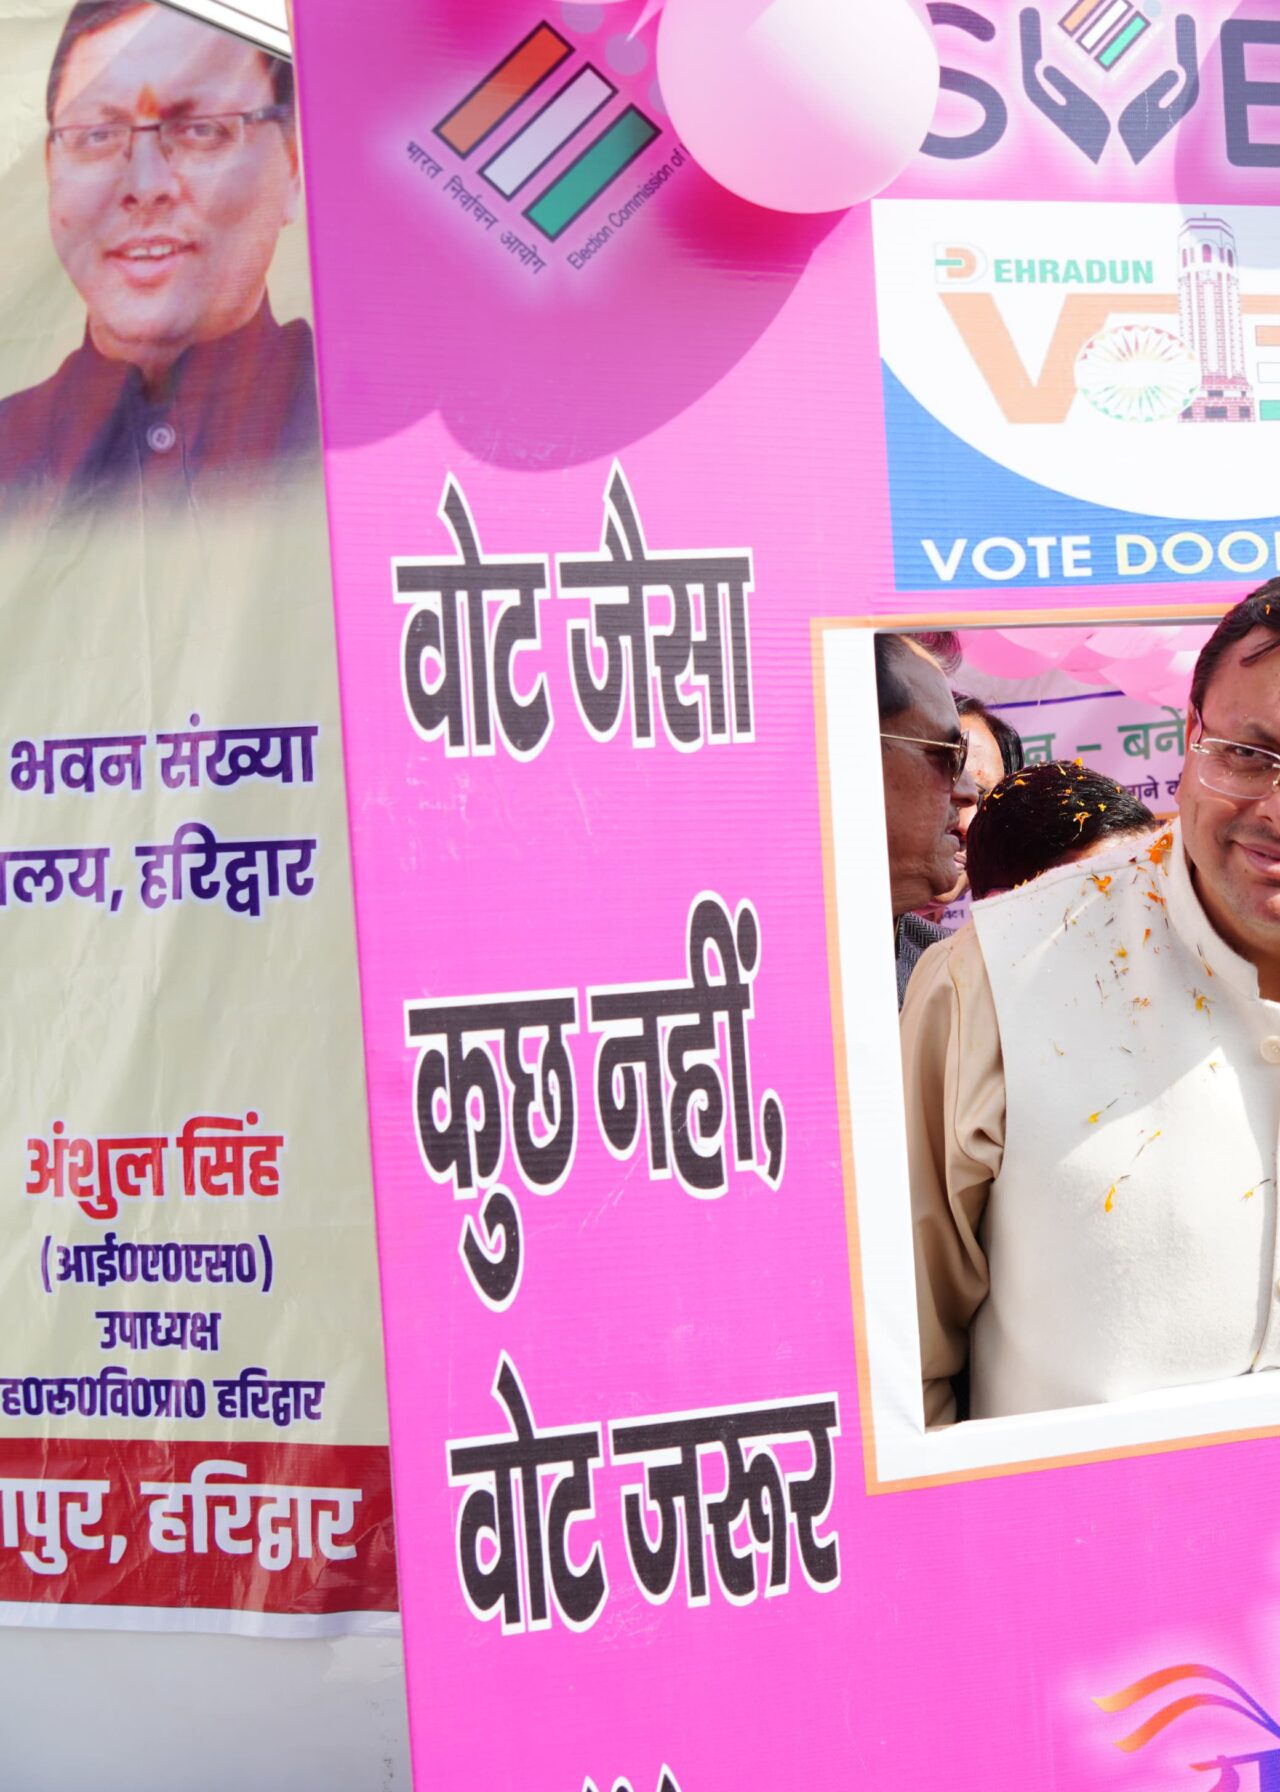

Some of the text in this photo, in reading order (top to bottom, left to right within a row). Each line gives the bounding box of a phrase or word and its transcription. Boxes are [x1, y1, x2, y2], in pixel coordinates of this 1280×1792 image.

[407, 141, 547, 275] भारत निर्वाचन आयोग
[566, 148, 686, 270] Election Commission of
[391, 457, 755, 762] वोट जैसा
[921, 535, 1093, 581] VOTE
[11, 712, 318, 794] भवन संख्या
[0, 822, 316, 916] ालय, हरिद्वार
[404, 890, 786, 1312] कुछ नहीं,
[26, 1111, 284, 1220] अंशुल सिंह
[96, 1310, 221, 1352] उपाध्यक्ष
[213, 1368, 325, 1426] हरिद्वार
[140, 1459, 362, 1572] हरिद्वार
[446, 1349, 841, 1636] वोट जरूर
